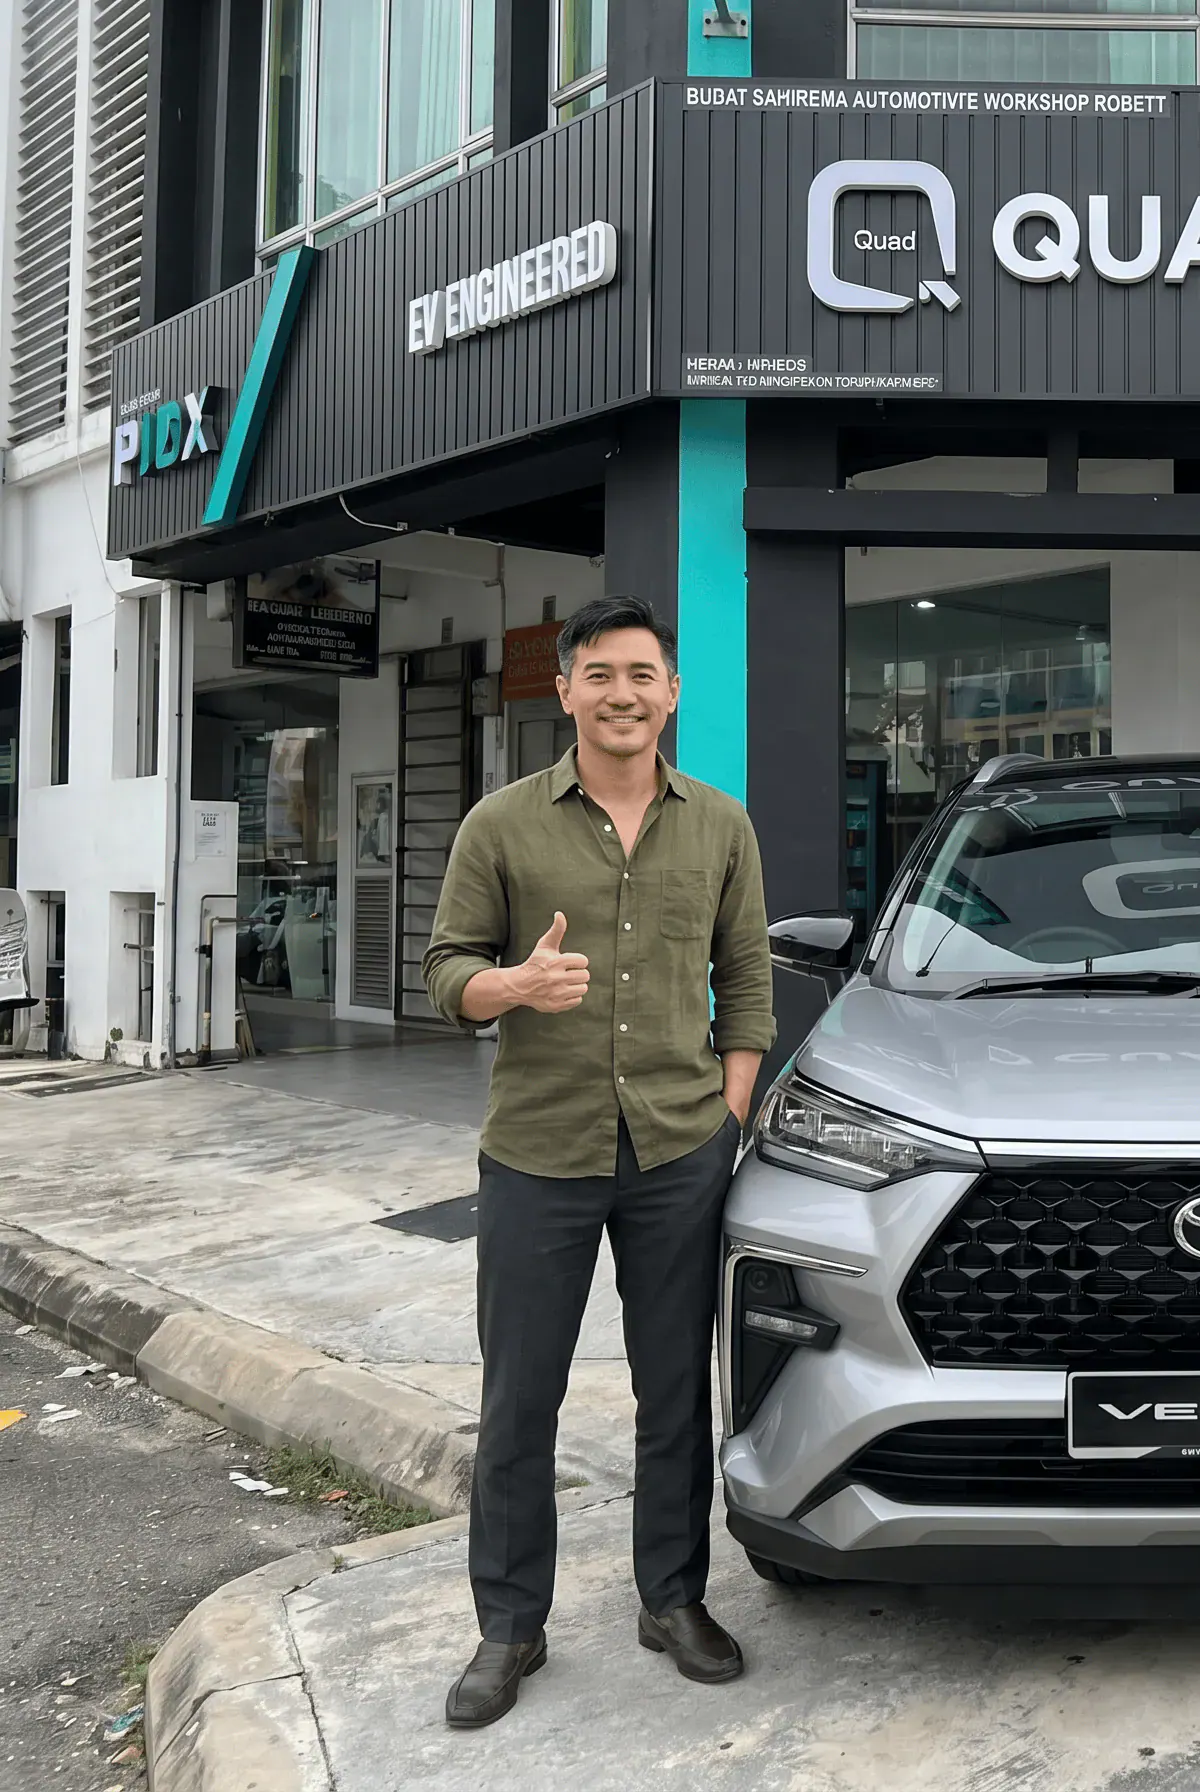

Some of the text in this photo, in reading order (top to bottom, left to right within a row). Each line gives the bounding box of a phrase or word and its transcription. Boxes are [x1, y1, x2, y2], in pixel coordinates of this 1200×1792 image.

[984, 92, 1089, 112] WORKSHOP
[1094, 94, 1167, 113] ROBETT
[854, 229, 916, 251] Quad
[408, 220, 614, 355] EV ENGINEERED
